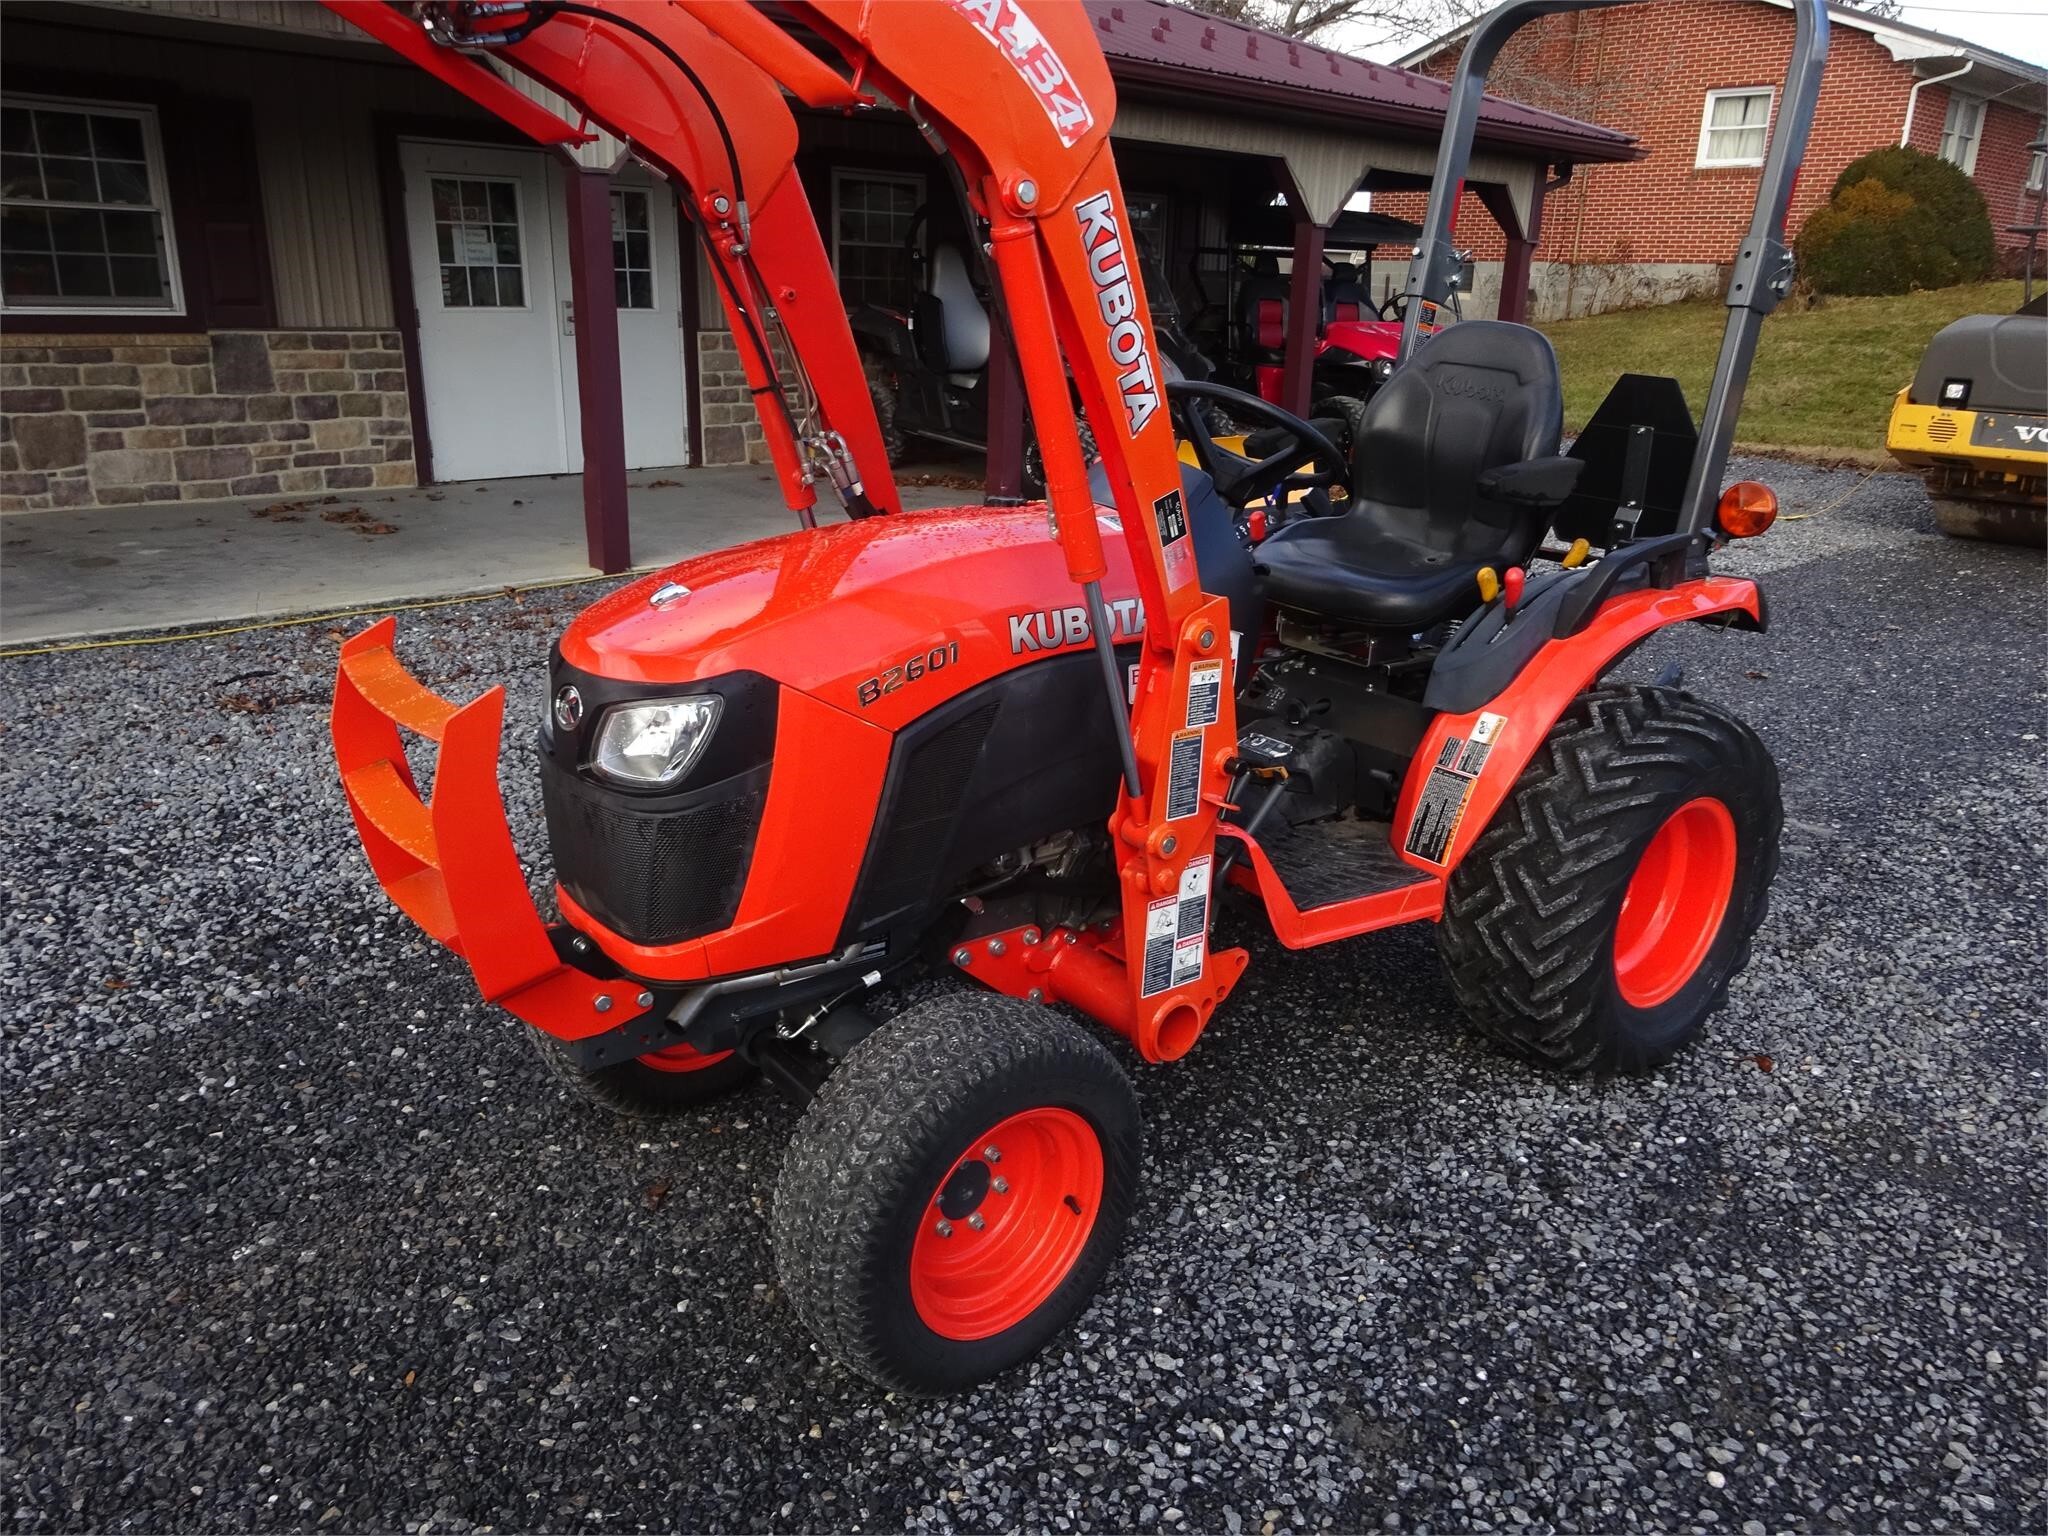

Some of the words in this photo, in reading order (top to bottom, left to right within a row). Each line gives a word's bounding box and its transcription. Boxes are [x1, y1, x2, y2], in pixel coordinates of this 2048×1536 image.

[1075, 193, 1160, 436] KUBOTA
[1437, 373, 1505, 403] Kubota
[857, 641, 959, 709] B2601
